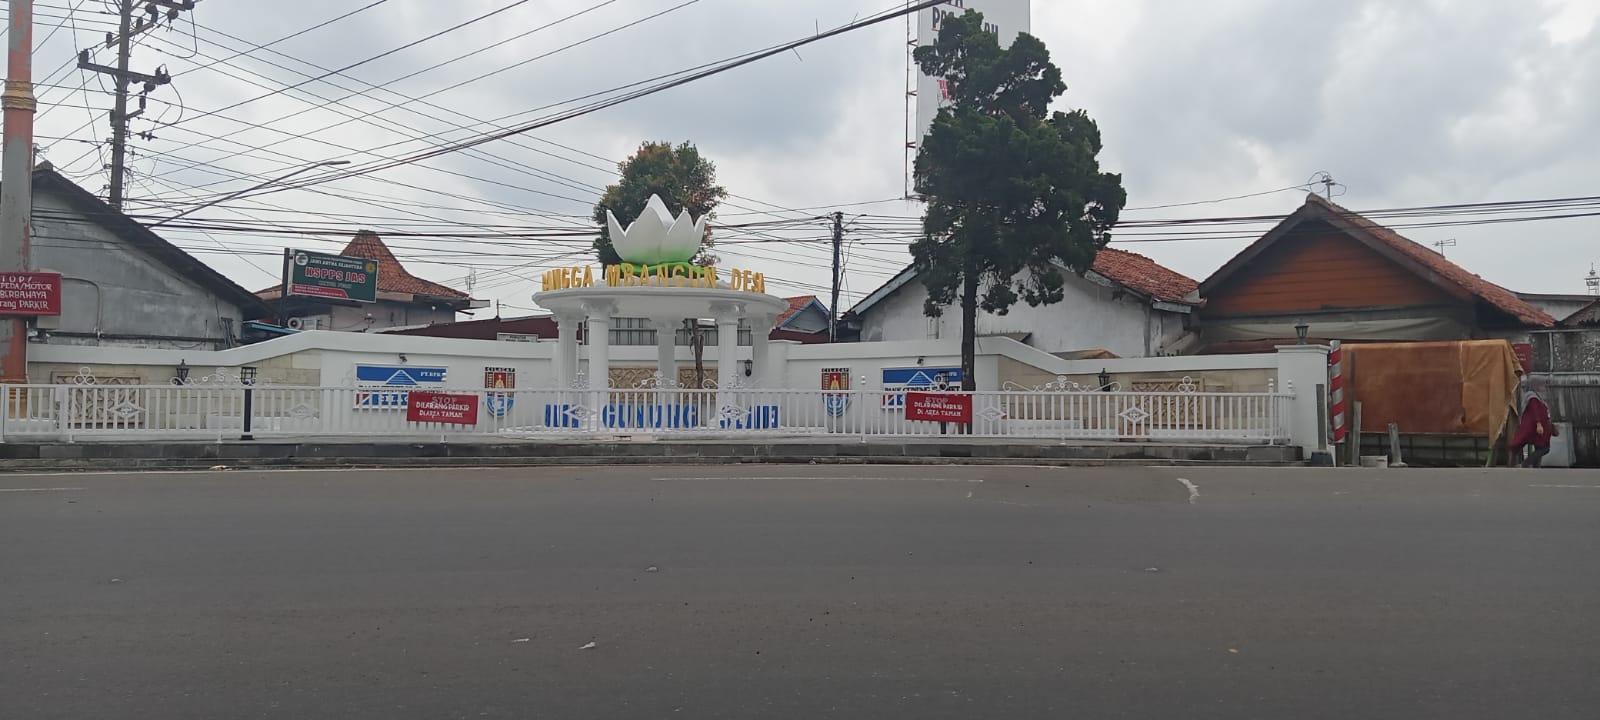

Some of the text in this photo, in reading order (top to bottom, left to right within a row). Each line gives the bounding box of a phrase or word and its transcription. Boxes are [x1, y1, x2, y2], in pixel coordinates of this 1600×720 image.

[305, 266, 366, 283] KSPPS JAS
[606, 263, 716, 289] MBANGUN
[731, 268, 765, 294] DESA
[19, 300, 48, 310] PARKIR
[416, 401, 447, 410] DILARANG
[602, 404, 696, 428] GUNUNG
